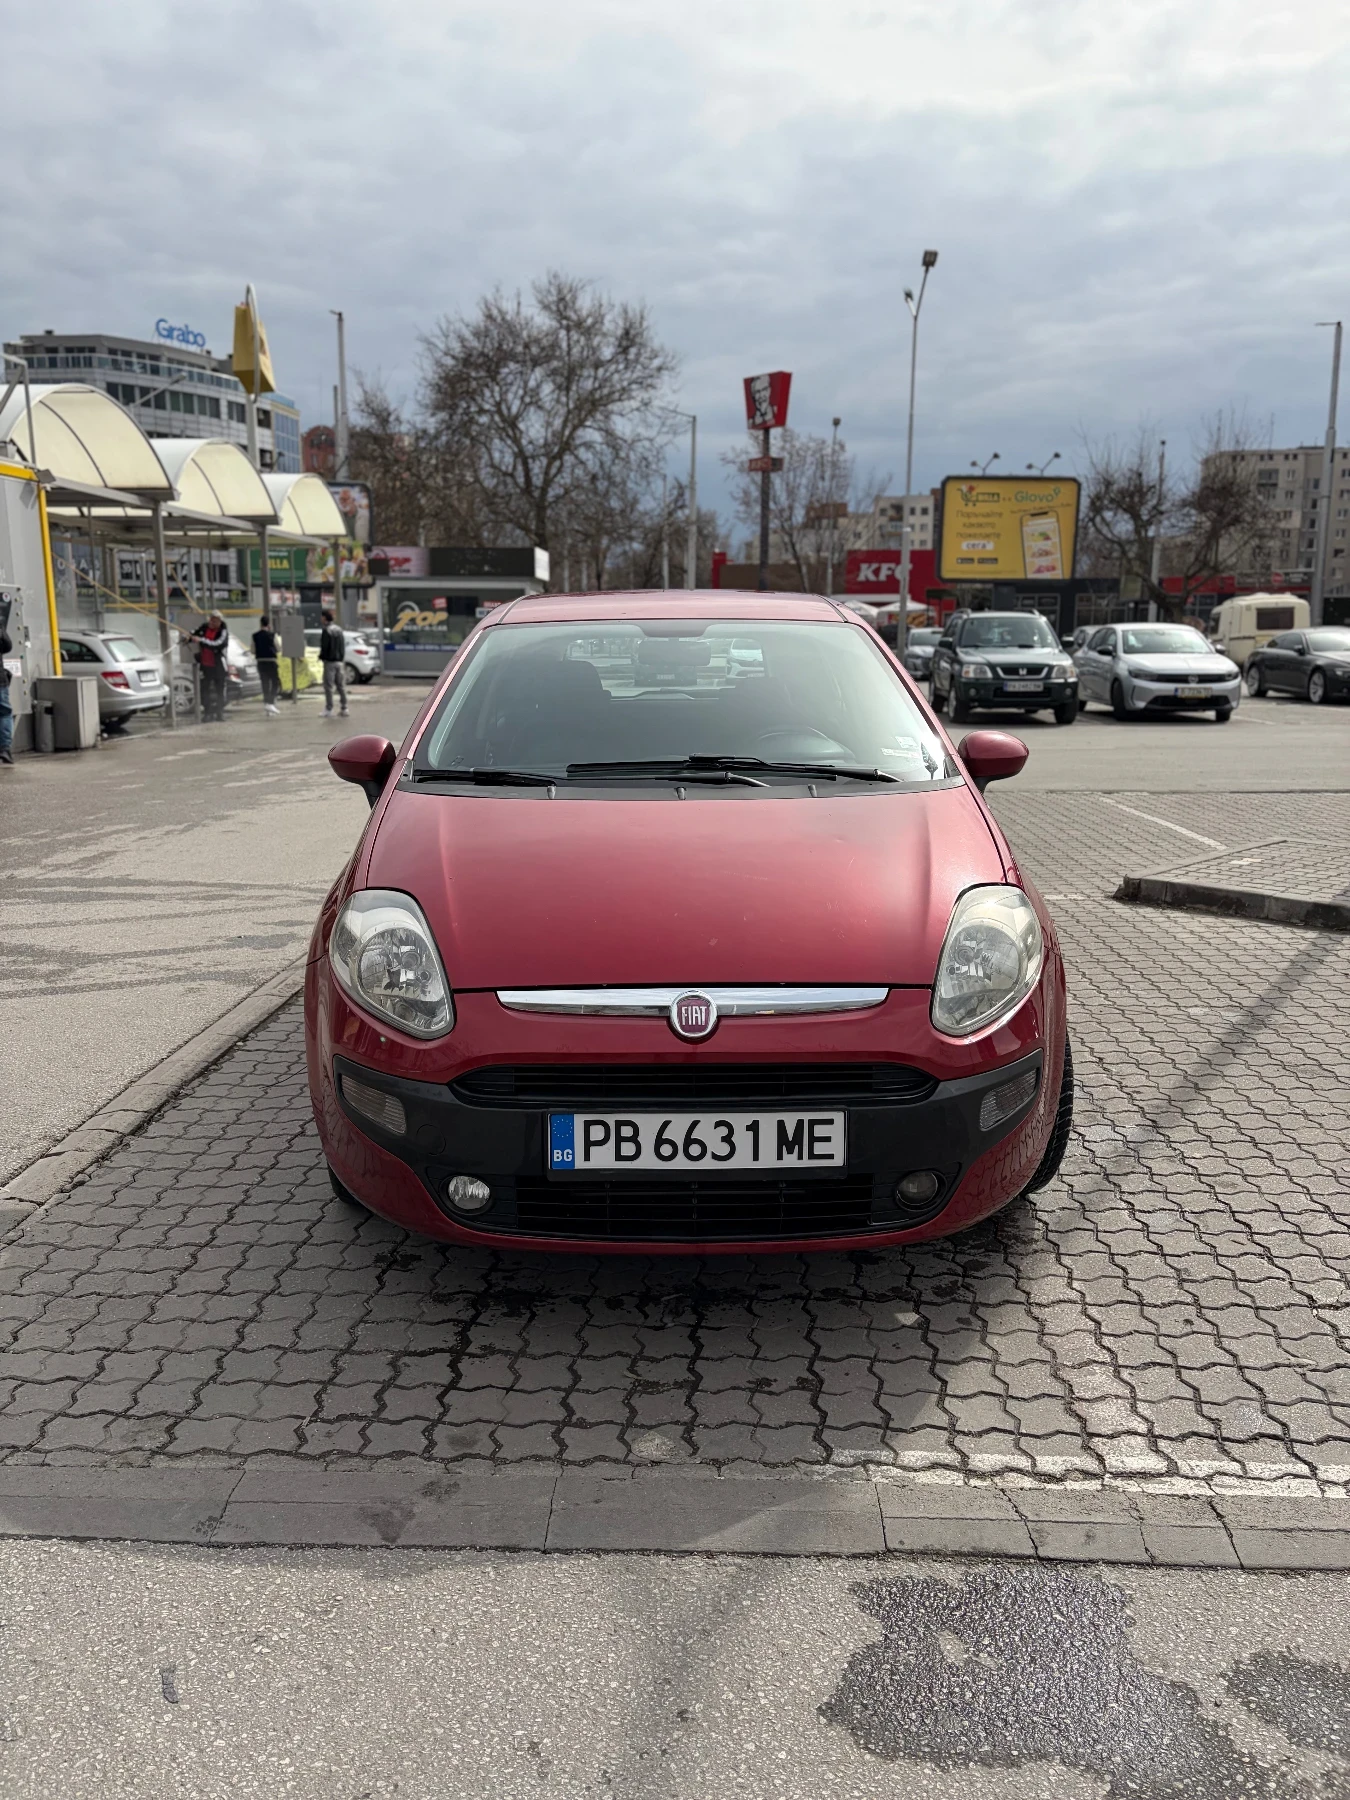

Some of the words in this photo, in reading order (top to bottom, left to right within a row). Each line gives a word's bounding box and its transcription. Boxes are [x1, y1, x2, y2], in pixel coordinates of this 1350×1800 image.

[155, 318, 206, 347] Grabo
[1014, 489, 1055, 503] Glovo
[391, 611, 449, 633] TOP
[681, 1005, 707, 1026] FIAT
[583, 1119, 642, 1162] PB
[653, 1119, 760, 1162] 6631
[776, 1118, 835, 1161] ME
[553, 1149, 573, 1162] BG
